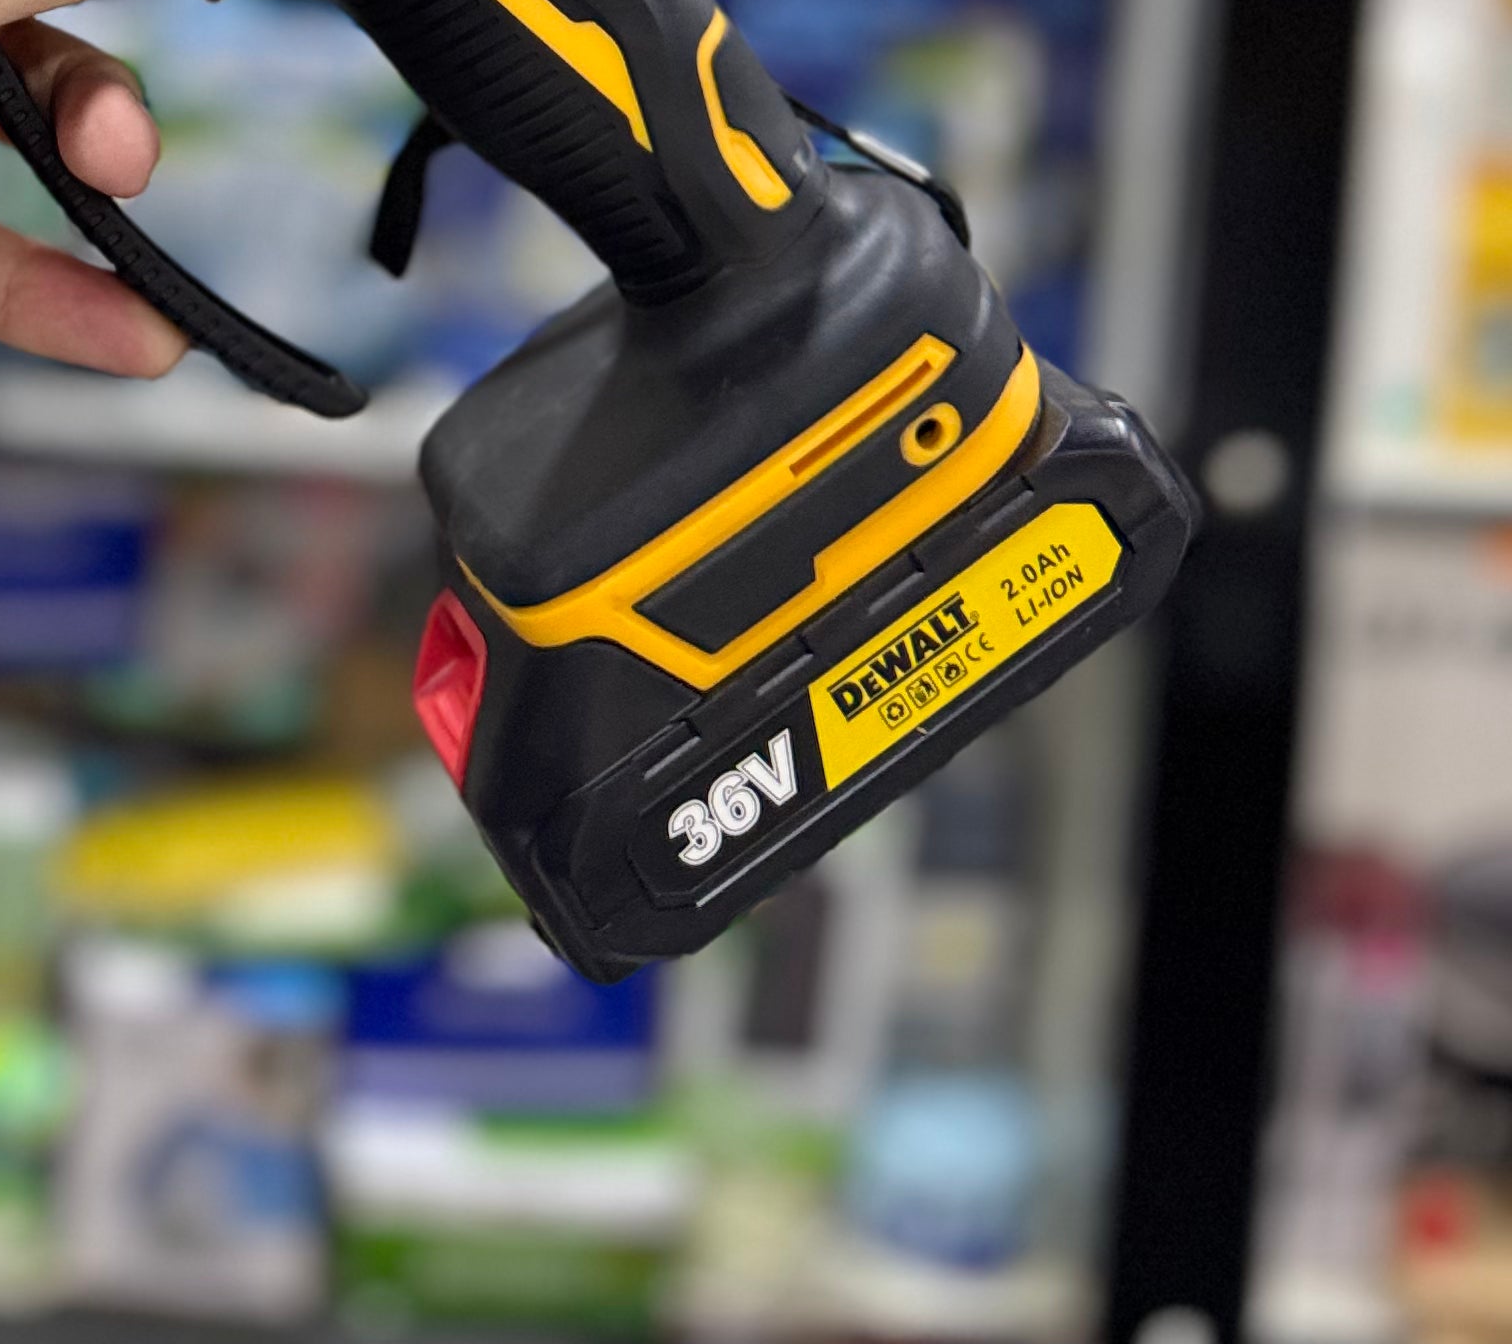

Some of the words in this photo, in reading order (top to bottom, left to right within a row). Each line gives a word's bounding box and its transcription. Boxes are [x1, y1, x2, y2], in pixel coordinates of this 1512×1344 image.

[1000, 543, 1071, 601] 2.0Ah
[1015, 564, 1084, 627] LI-ION
[668, 728, 798, 866] 36V
